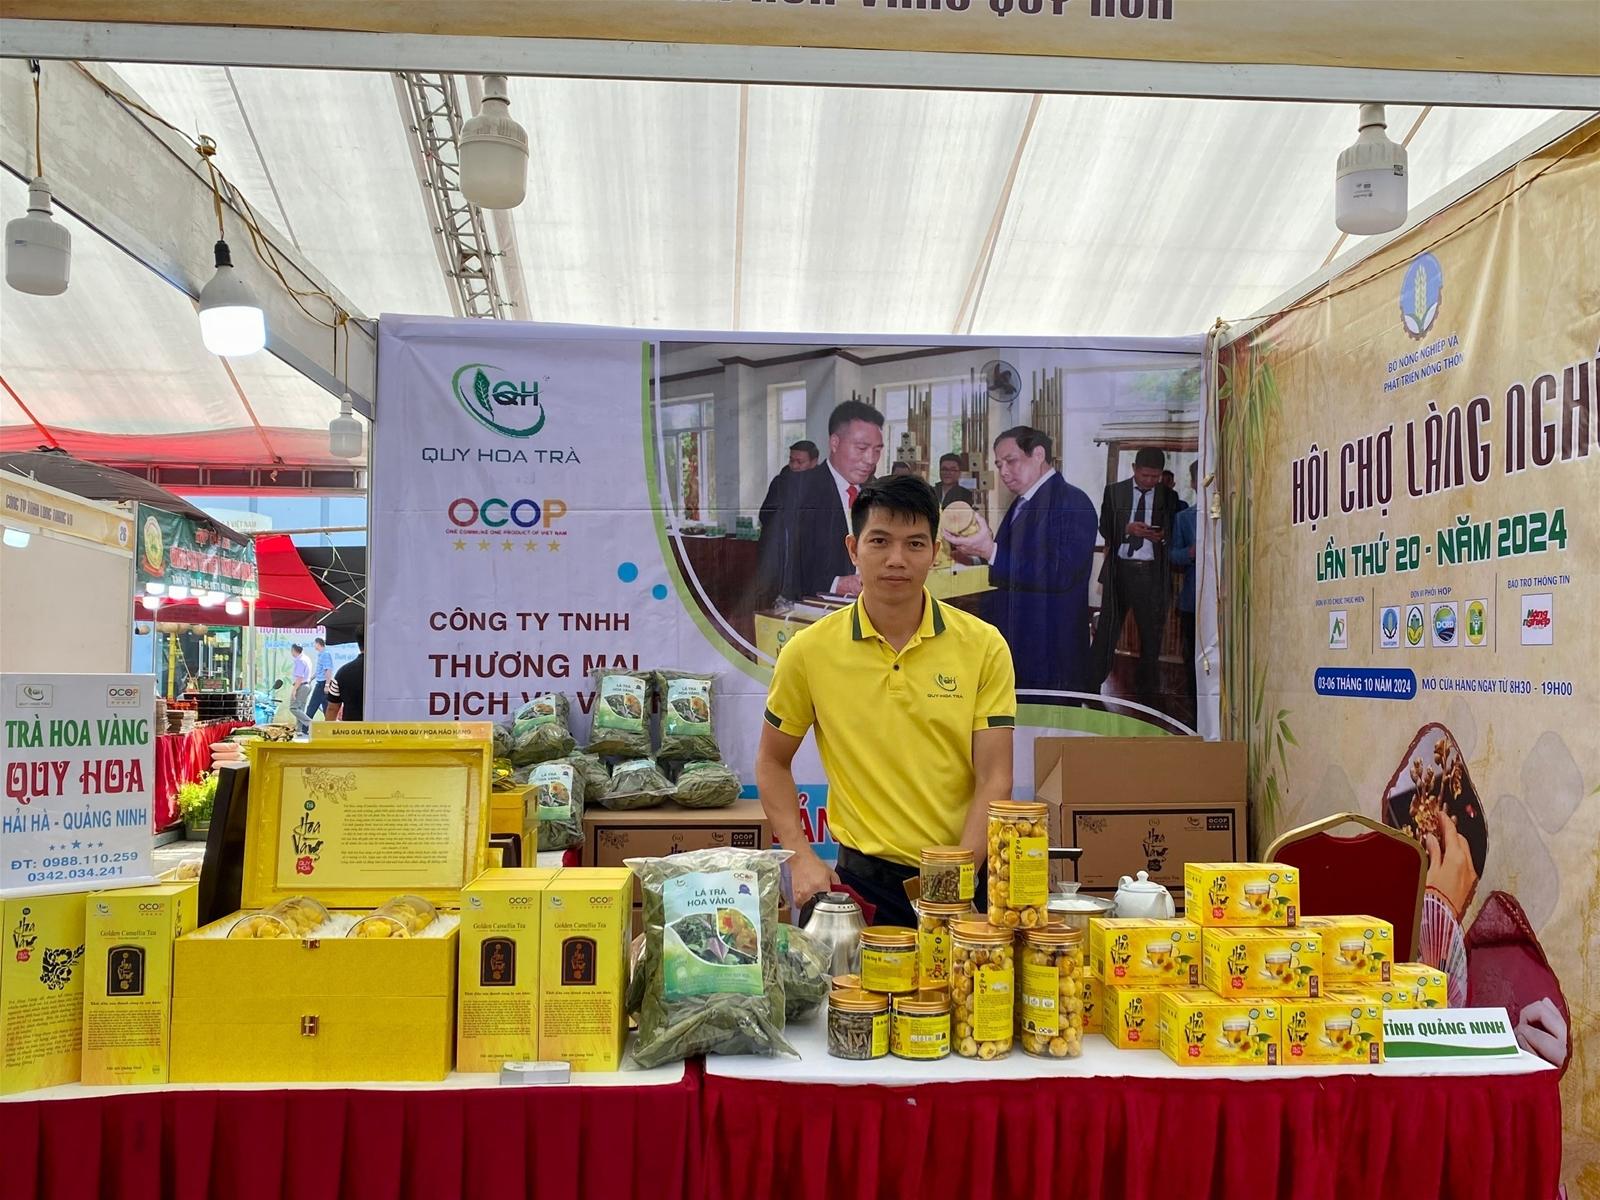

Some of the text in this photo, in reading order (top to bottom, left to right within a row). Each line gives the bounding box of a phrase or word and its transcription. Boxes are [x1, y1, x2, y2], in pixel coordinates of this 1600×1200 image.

[422, 446, 581, 464] QUY HOA TRÀ
[1292, 443, 1328, 531] HỘI
[1340, 425, 1394, 517] CHỢ
[1406, 397, 1491, 497] LÀNG
[448, 497, 568, 528] OCOP
[1316, 536, 1346, 582] LẦN
[1352, 532, 1390, 576] THỨ
[1396, 535, 1420, 572] 20
[1437, 515, 1492, 566] NĂM
[1498, 508, 1568, 557] 2024
[1559, 575, 1570, 585] TIN
[430, 606, 630, 631] CÔNG TY TNHH
[428, 651, 570, 678] THƯƠNG
[109, 688, 139, 696] OCOP
[1318, 674, 1411, 693] 03-06 THÁNG 10 NĂM 2024
[1510, 680, 1531, 694] 8H30
[1541, 682, 1573, 696] 19H00
[429, 692, 508, 720] DỊCH
[5, 713, 149, 748] TRÀ HOA VÀNG
[6, 759, 145, 806] QUY HOA
[3, 808, 26, 833] HẢI
[31, 809, 50, 832] HÀ
[63, 804, 111, 830] QUẢNG
[116, 808, 147, 827] NINH
[11, 852, 138, 870] ĐT: 0988.110.259
[28, 866, 124, 882] 0342.034.241
[1418, 1018, 1465, 1036] QUẢNG
[1470, 1021, 1506, 1034] NINH
